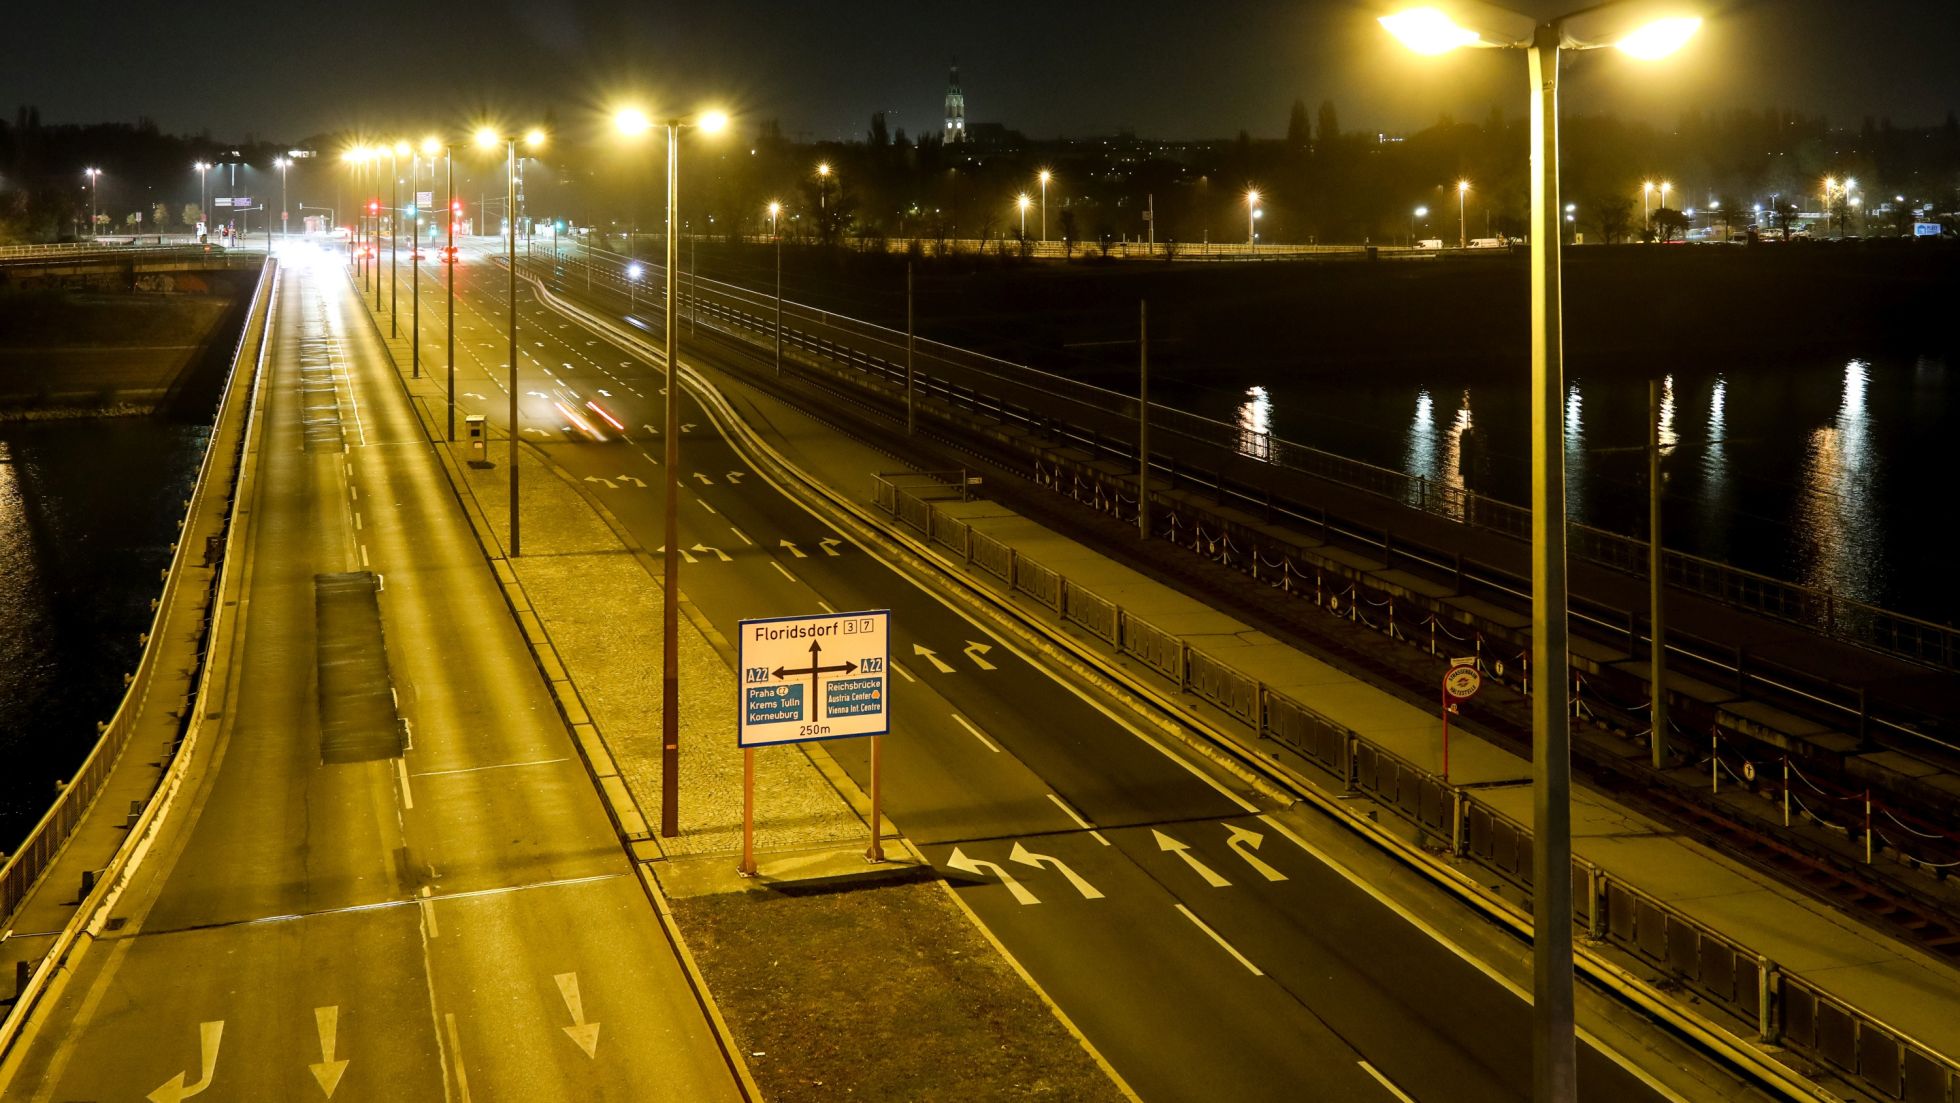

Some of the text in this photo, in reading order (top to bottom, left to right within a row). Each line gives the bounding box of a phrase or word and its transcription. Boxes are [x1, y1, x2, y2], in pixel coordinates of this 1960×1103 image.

[756, 621, 870, 641] Floridsdorf 3 7
[861, 658, 882, 672] A22
[747, 668, 768, 682] A22
[828, 681, 880, 691] Reichsbrücke
[750, 690, 774, 698] Praha
[828, 693, 850, 703] Austria
[750, 698, 799, 709] Krems Tulln
[828, 706, 849, 714] Vienna
[750, 710, 798, 722] Korneuburg
[800, 725, 830, 736] 250m
